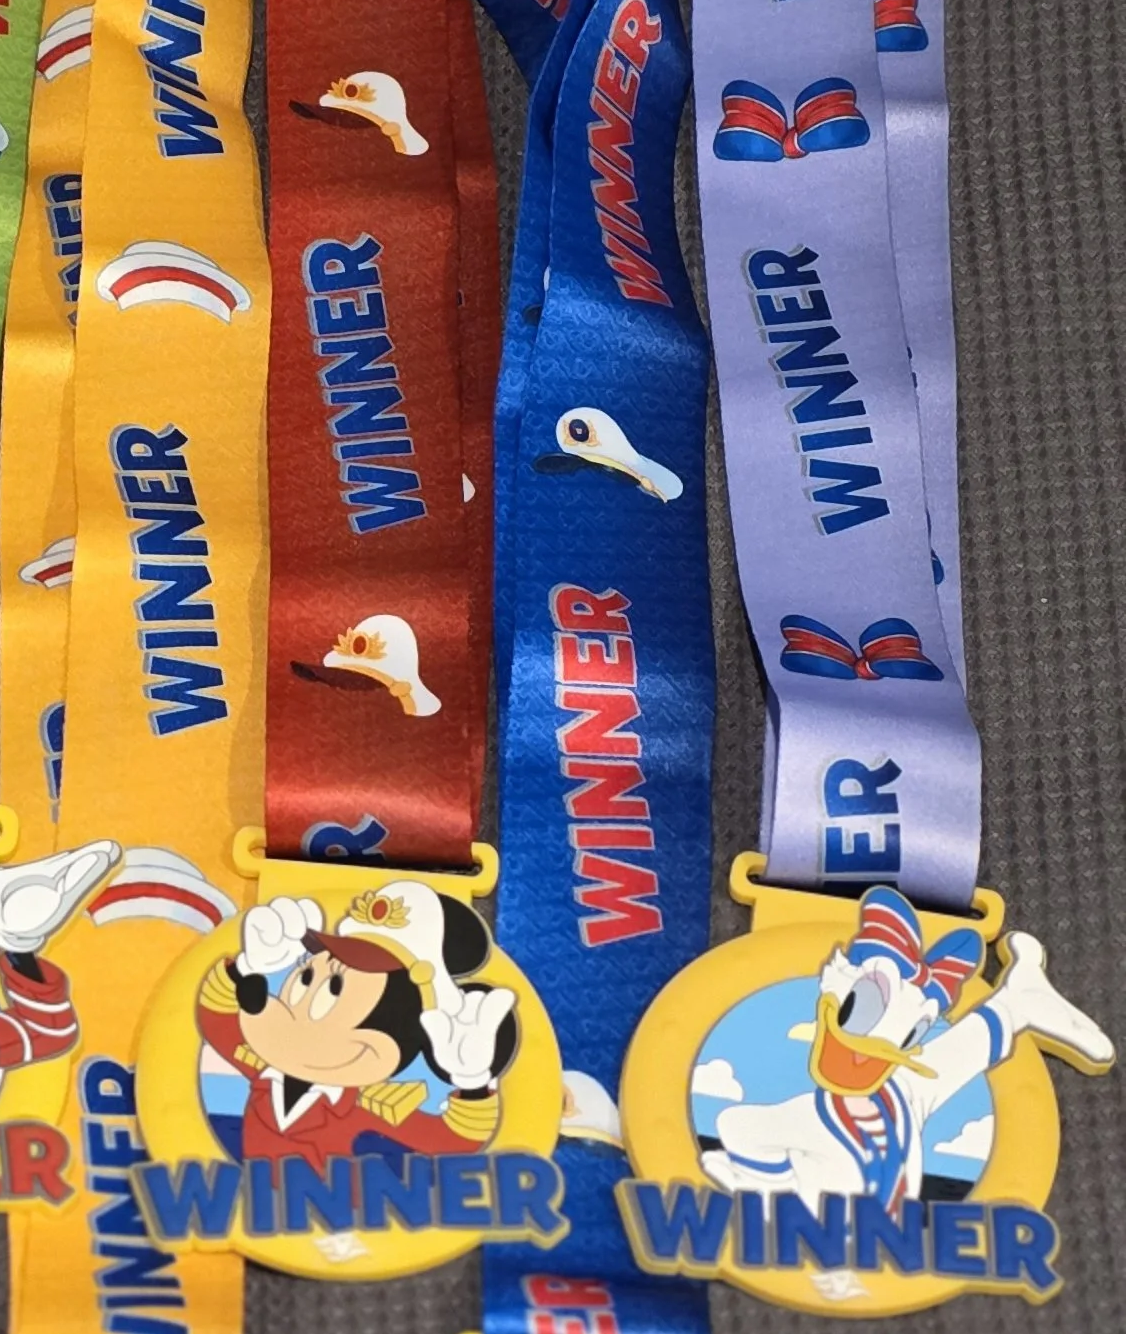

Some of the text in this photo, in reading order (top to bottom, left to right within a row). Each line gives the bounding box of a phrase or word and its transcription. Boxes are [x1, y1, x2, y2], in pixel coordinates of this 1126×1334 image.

[302, 231, 428, 536] WINNER
[743, 242, 891, 537] WINNER
[108, 421, 230, 737] WINNER
[549, 583, 664, 948] WINNER
[137, 1151, 566, 1243] WINNER
[626, 1177, 1061, 1294] WINNER
